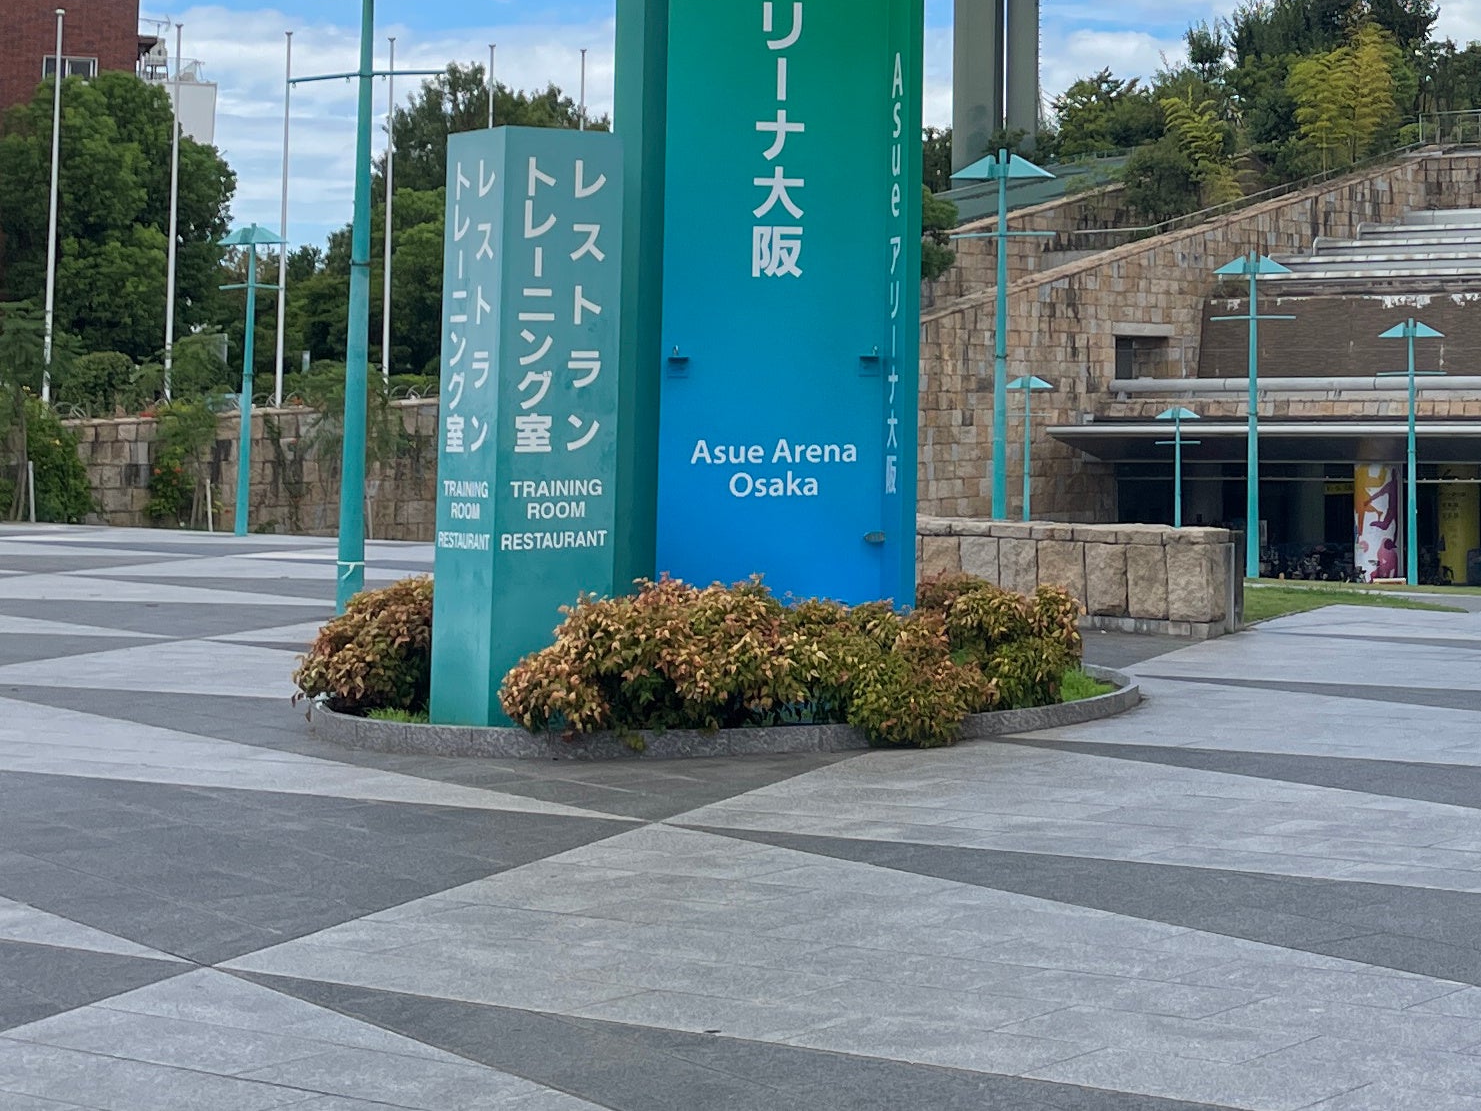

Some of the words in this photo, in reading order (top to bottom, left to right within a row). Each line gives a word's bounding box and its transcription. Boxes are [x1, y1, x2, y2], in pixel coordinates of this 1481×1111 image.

[890, 52, 904, 217] Asue
[445, 161, 471, 454] トレーニング室
[469, 159, 497, 452] レストラン
[514, 156, 557, 454] トレーニング室
[566, 158, 607, 452] レストラン
[885, 236, 903, 495] アリーナ大阪
[691, 439, 764, 465] Asue
[772, 438, 857, 464] Arena
[443, 480, 489, 500] TRAINING
[510, 479, 602, 499] TRAINING
[729, 471, 819, 497] Osaka
[451, 502, 480, 520] ROOM
[527, 501, 586, 520] ROOM
[438, 531, 491, 551] RESTAURANT
[501, 529, 608, 551] RESTAURANT
